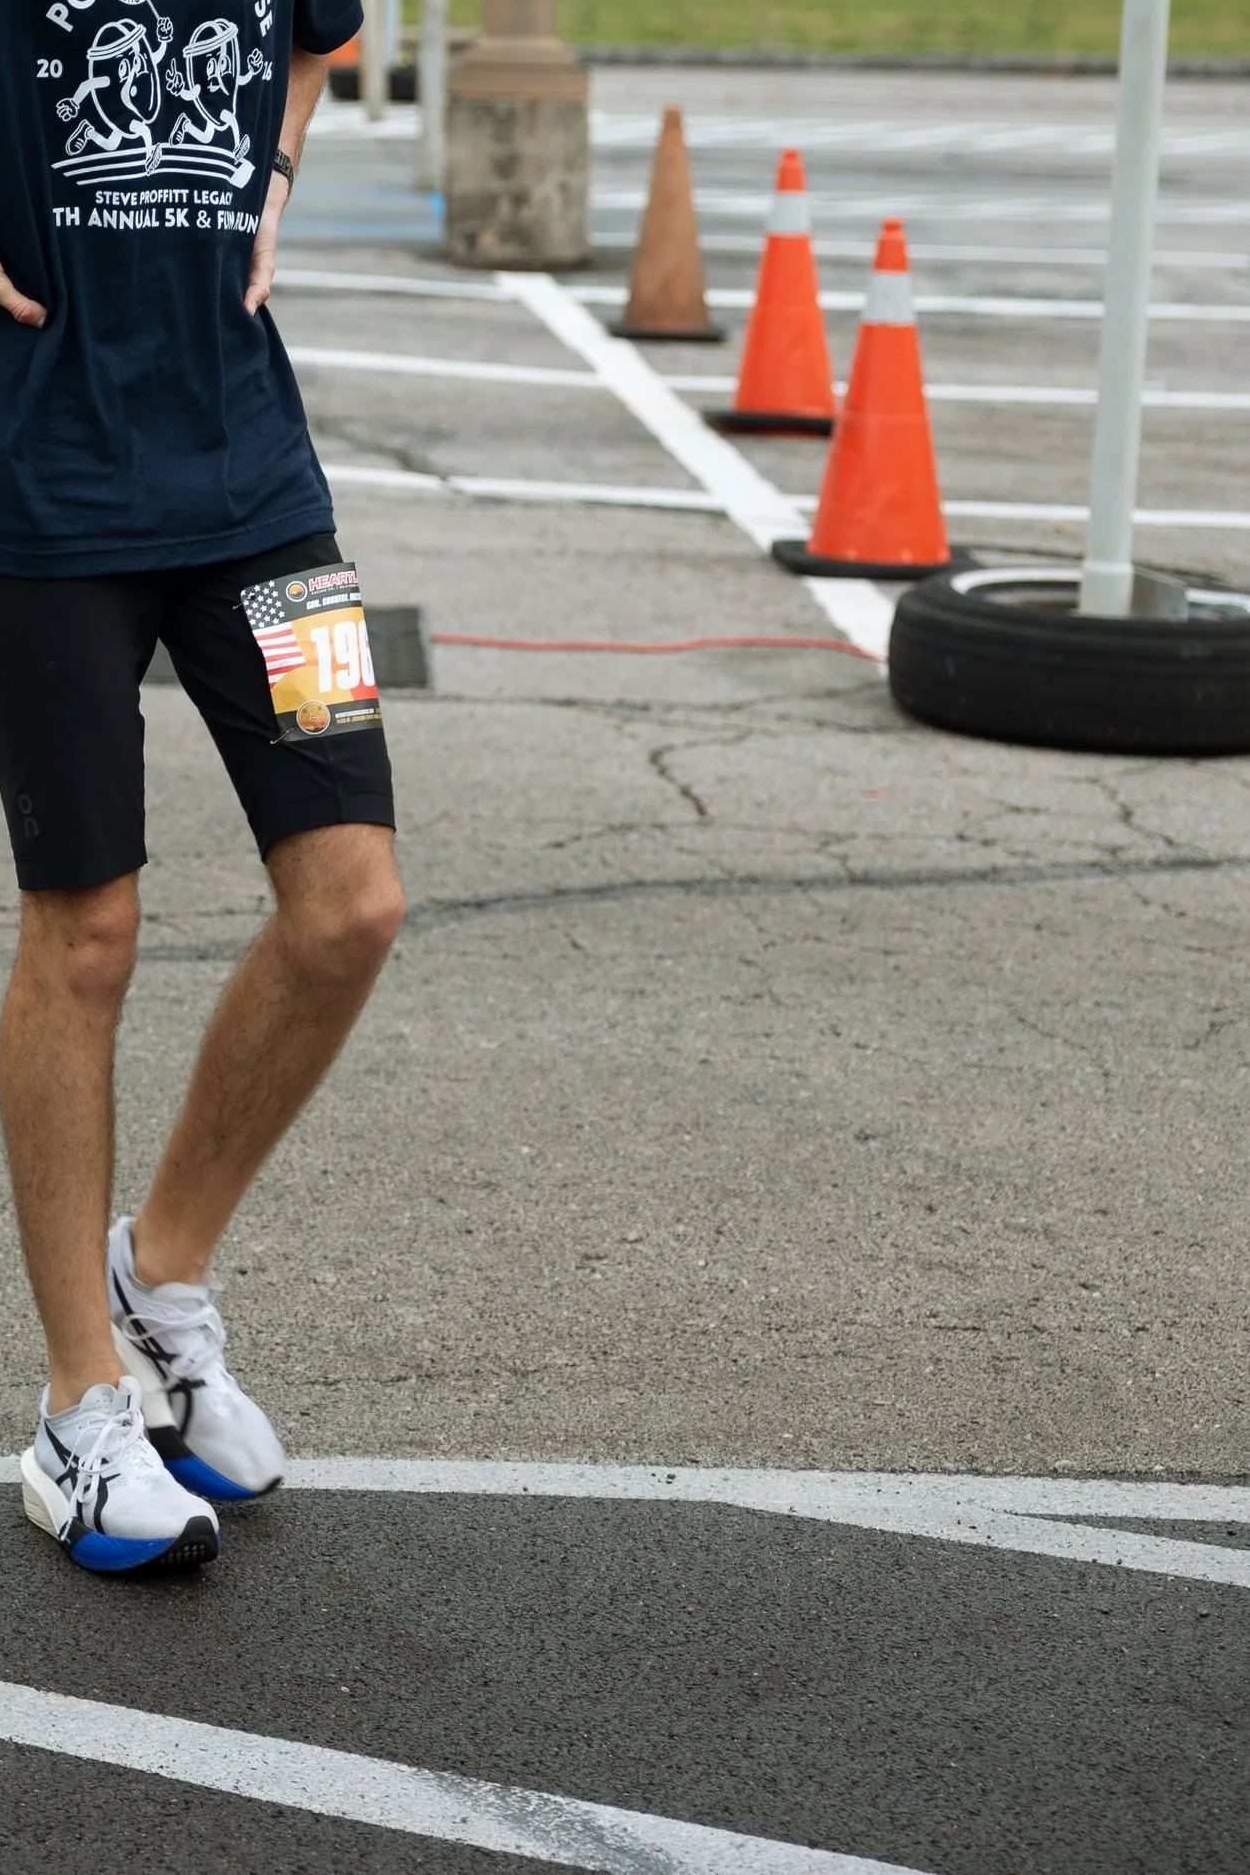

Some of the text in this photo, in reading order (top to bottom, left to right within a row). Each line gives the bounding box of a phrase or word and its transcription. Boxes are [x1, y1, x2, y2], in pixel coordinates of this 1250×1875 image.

[37, 59, 63, 78] 20
[95, 190, 138, 206] STEVE
[139, 189, 189, 205] PROFFITT
[87, 207, 160, 230] ANNUAL
[164, 208, 190, 228] 5K
[196, 210, 211, 229] &
